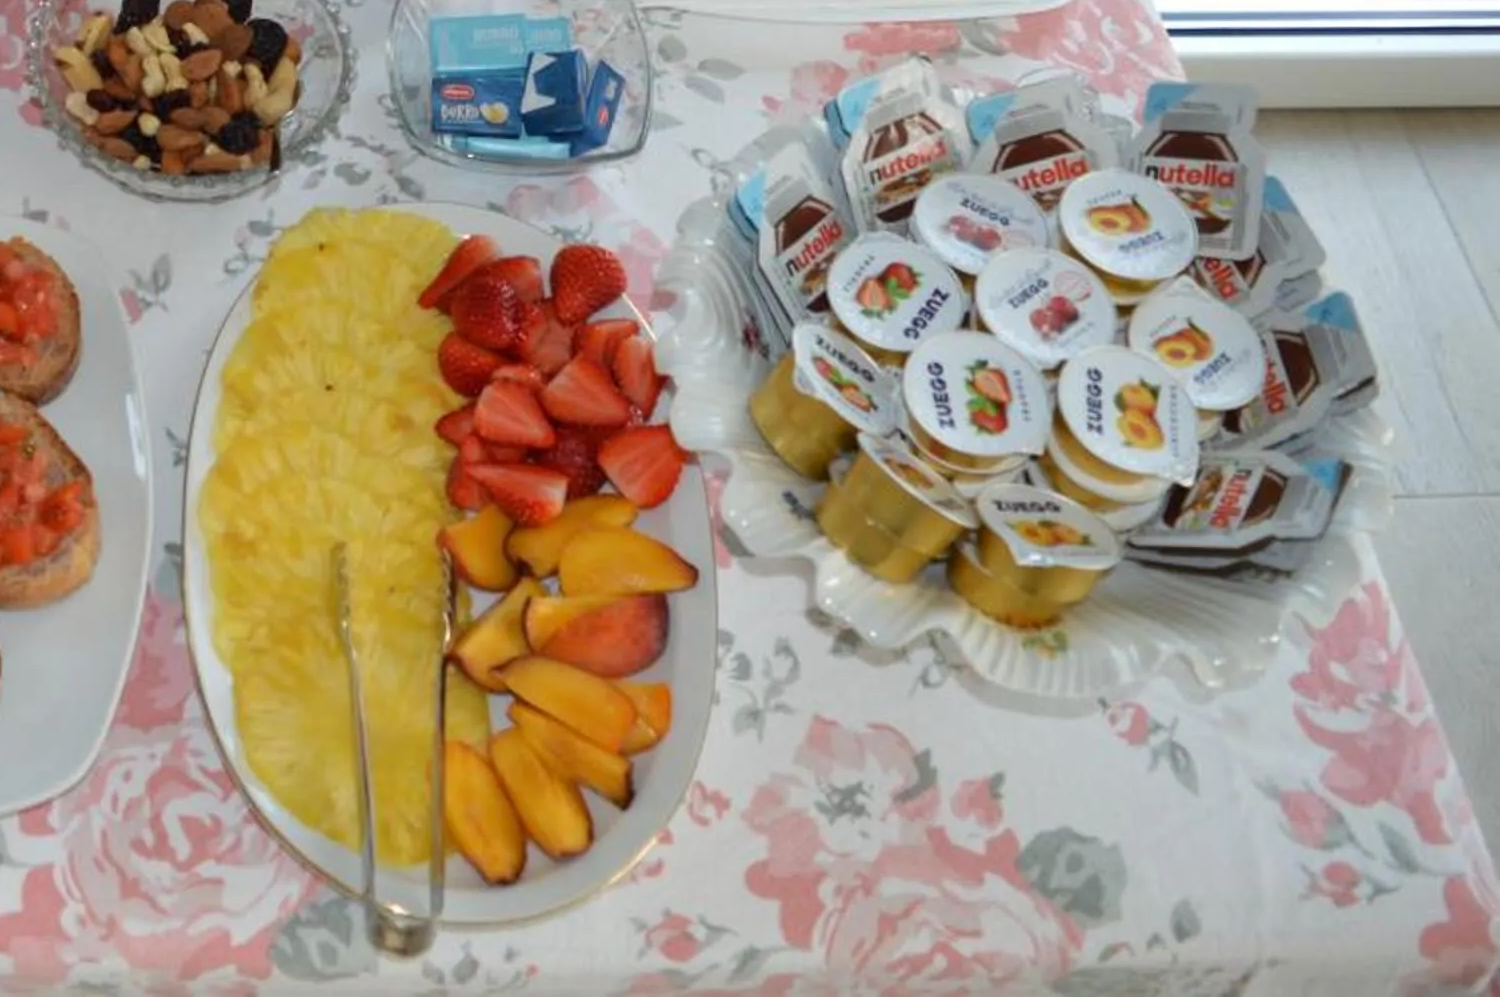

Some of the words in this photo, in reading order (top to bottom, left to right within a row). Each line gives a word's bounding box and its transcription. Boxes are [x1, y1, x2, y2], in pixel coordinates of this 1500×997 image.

[868, 140, 948, 185] nutella
[1013, 157, 1091, 190] utella
[1145, 164, 1236, 188] nutella
[961, 198, 1010, 227] ZUEGG
[786, 220, 844, 277] nutella
[903, 288, 949, 340] ZUEGG
[1008, 278, 1049, 309] ZUEGG
[927, 362, 956, 430] ZUEGG
[1086, 366, 1104, 436] ZUEGG
[996, 499, 1062, 513] ZUEGG
[1211, 469, 1252, 529] nutella
